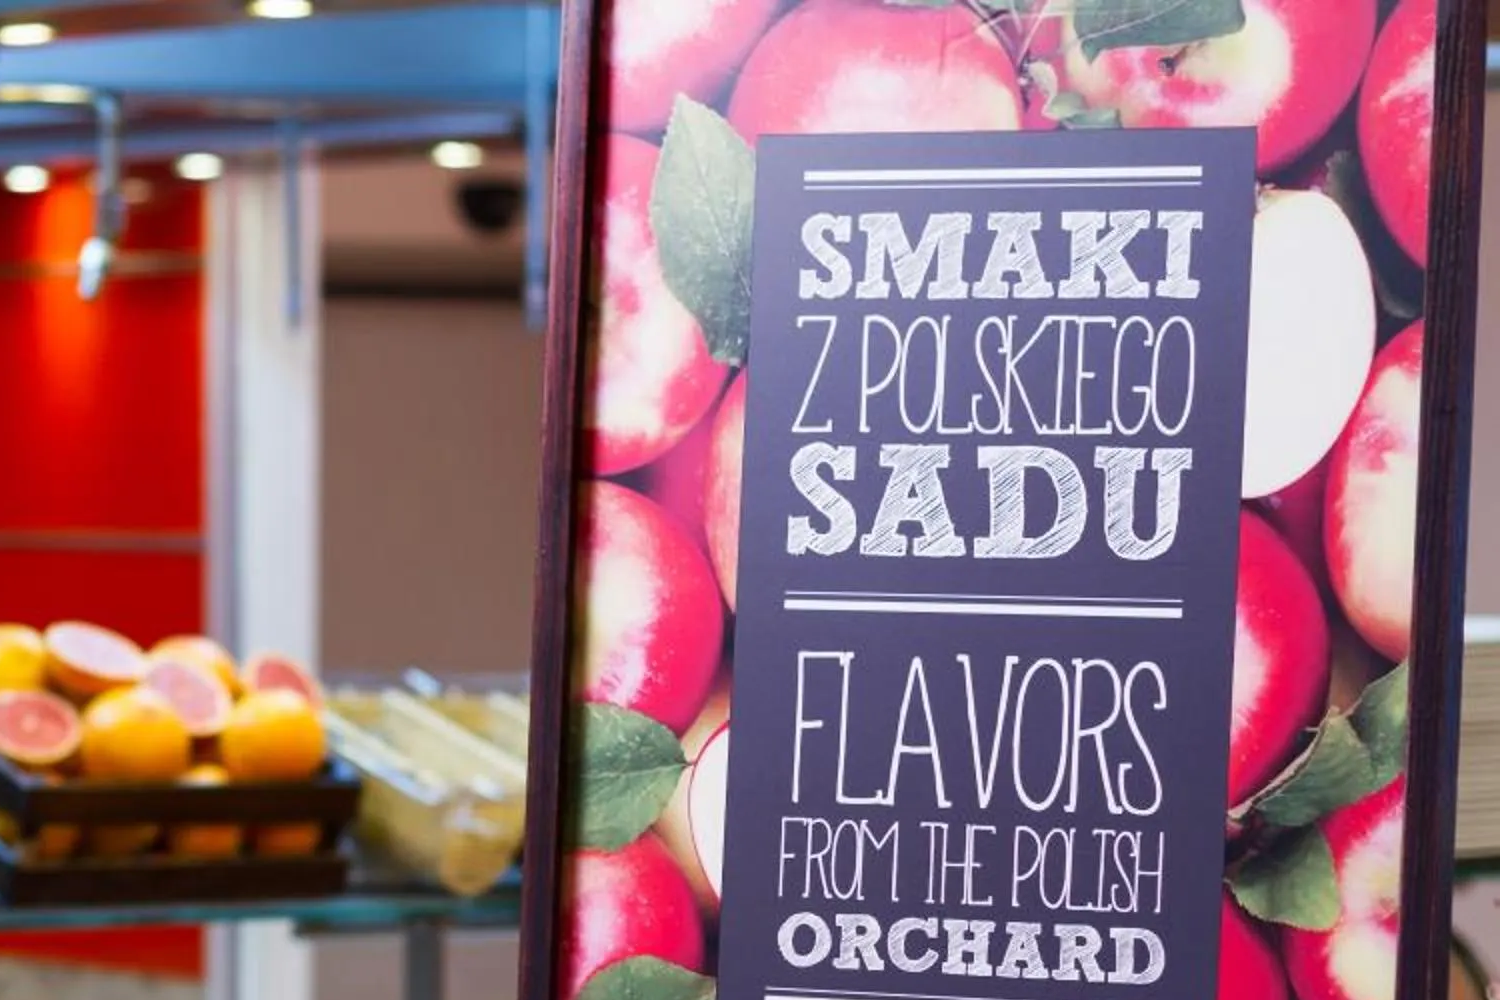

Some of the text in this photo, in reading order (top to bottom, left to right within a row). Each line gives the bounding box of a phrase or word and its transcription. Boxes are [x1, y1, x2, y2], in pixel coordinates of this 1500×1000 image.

[799, 210, 1203, 300] SMAKI
[792, 314, 1195, 436] Z POLSKIEGO
[787, 442, 1193, 561] SADU
[792, 651, 1168, 815] FLAVORS
[778, 817, 1164, 914] FROM THE POLISH
[777, 912, 1166, 985] ORCHARD
